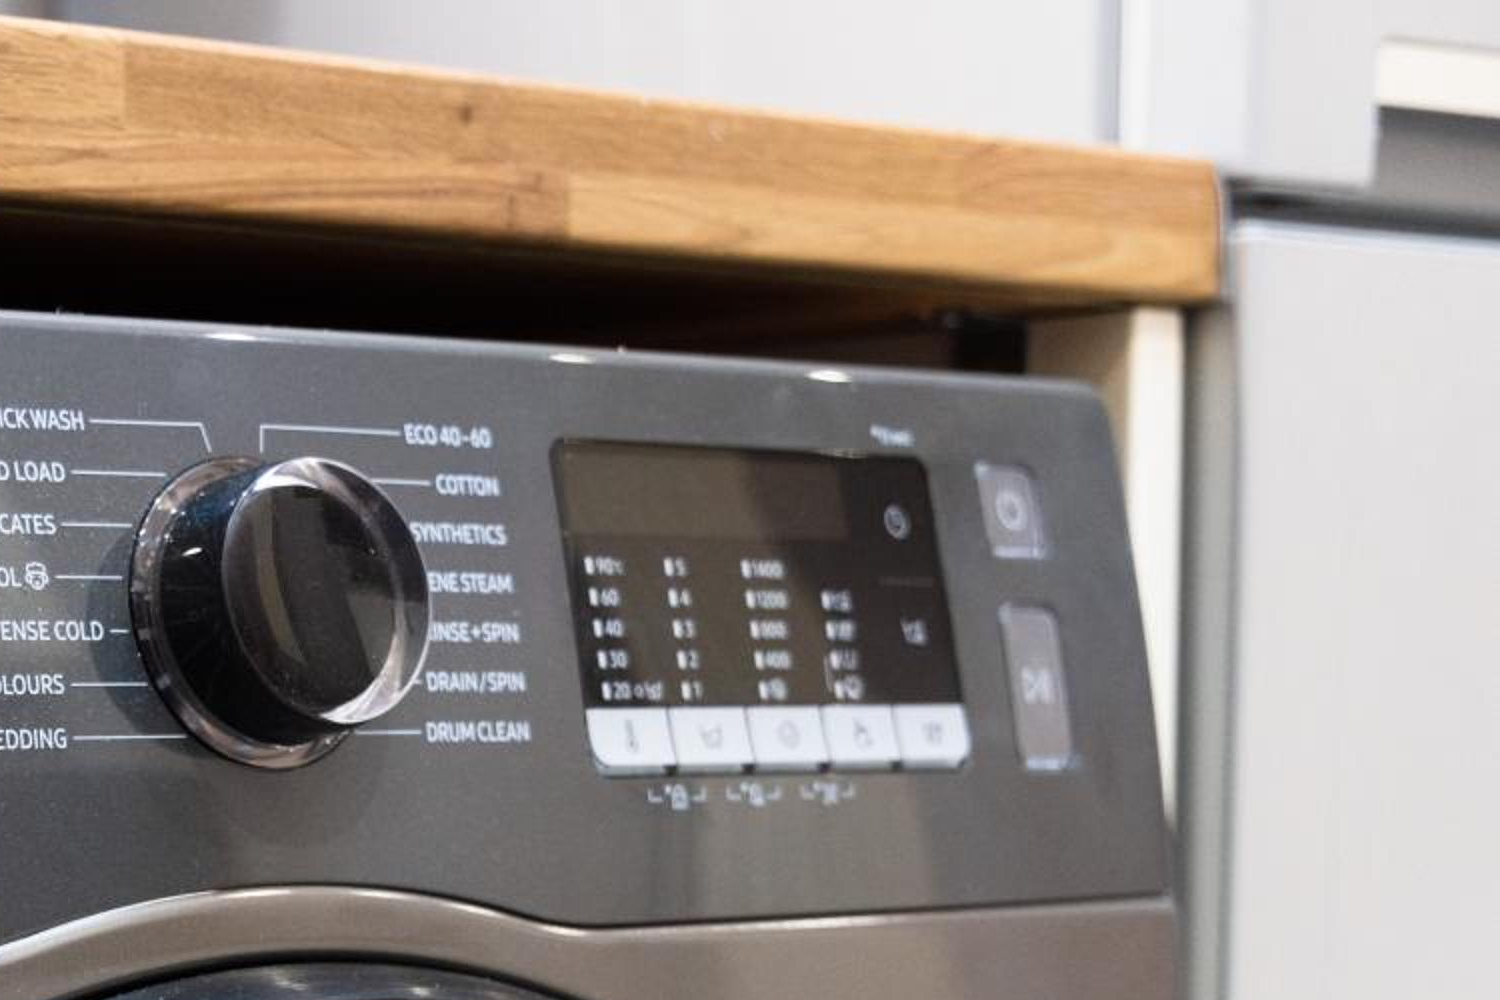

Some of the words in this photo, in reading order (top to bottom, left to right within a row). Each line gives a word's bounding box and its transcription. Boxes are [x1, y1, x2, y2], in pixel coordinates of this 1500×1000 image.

[29, 408, 85, 431] WASH
[403, 423, 438, 445] ECO
[13, 461, 66, 482] LOAD
[435, 473, 500, 496] COTTON
[409, 521, 508, 545] SYNTHETICS
[426, 571, 459, 593] ENE
[459, 573, 514, 594] STEAM
[53, 620, 104, 641] COLD
[428, 621, 521, 643] INSE+SPIN
[605, 618, 624, 639] 40
[609, 649, 629, 670] 30
[612, 680, 632, 699] 20
[425, 720, 476, 742] DRUM
[477, 720, 532, 742] CLEAN
